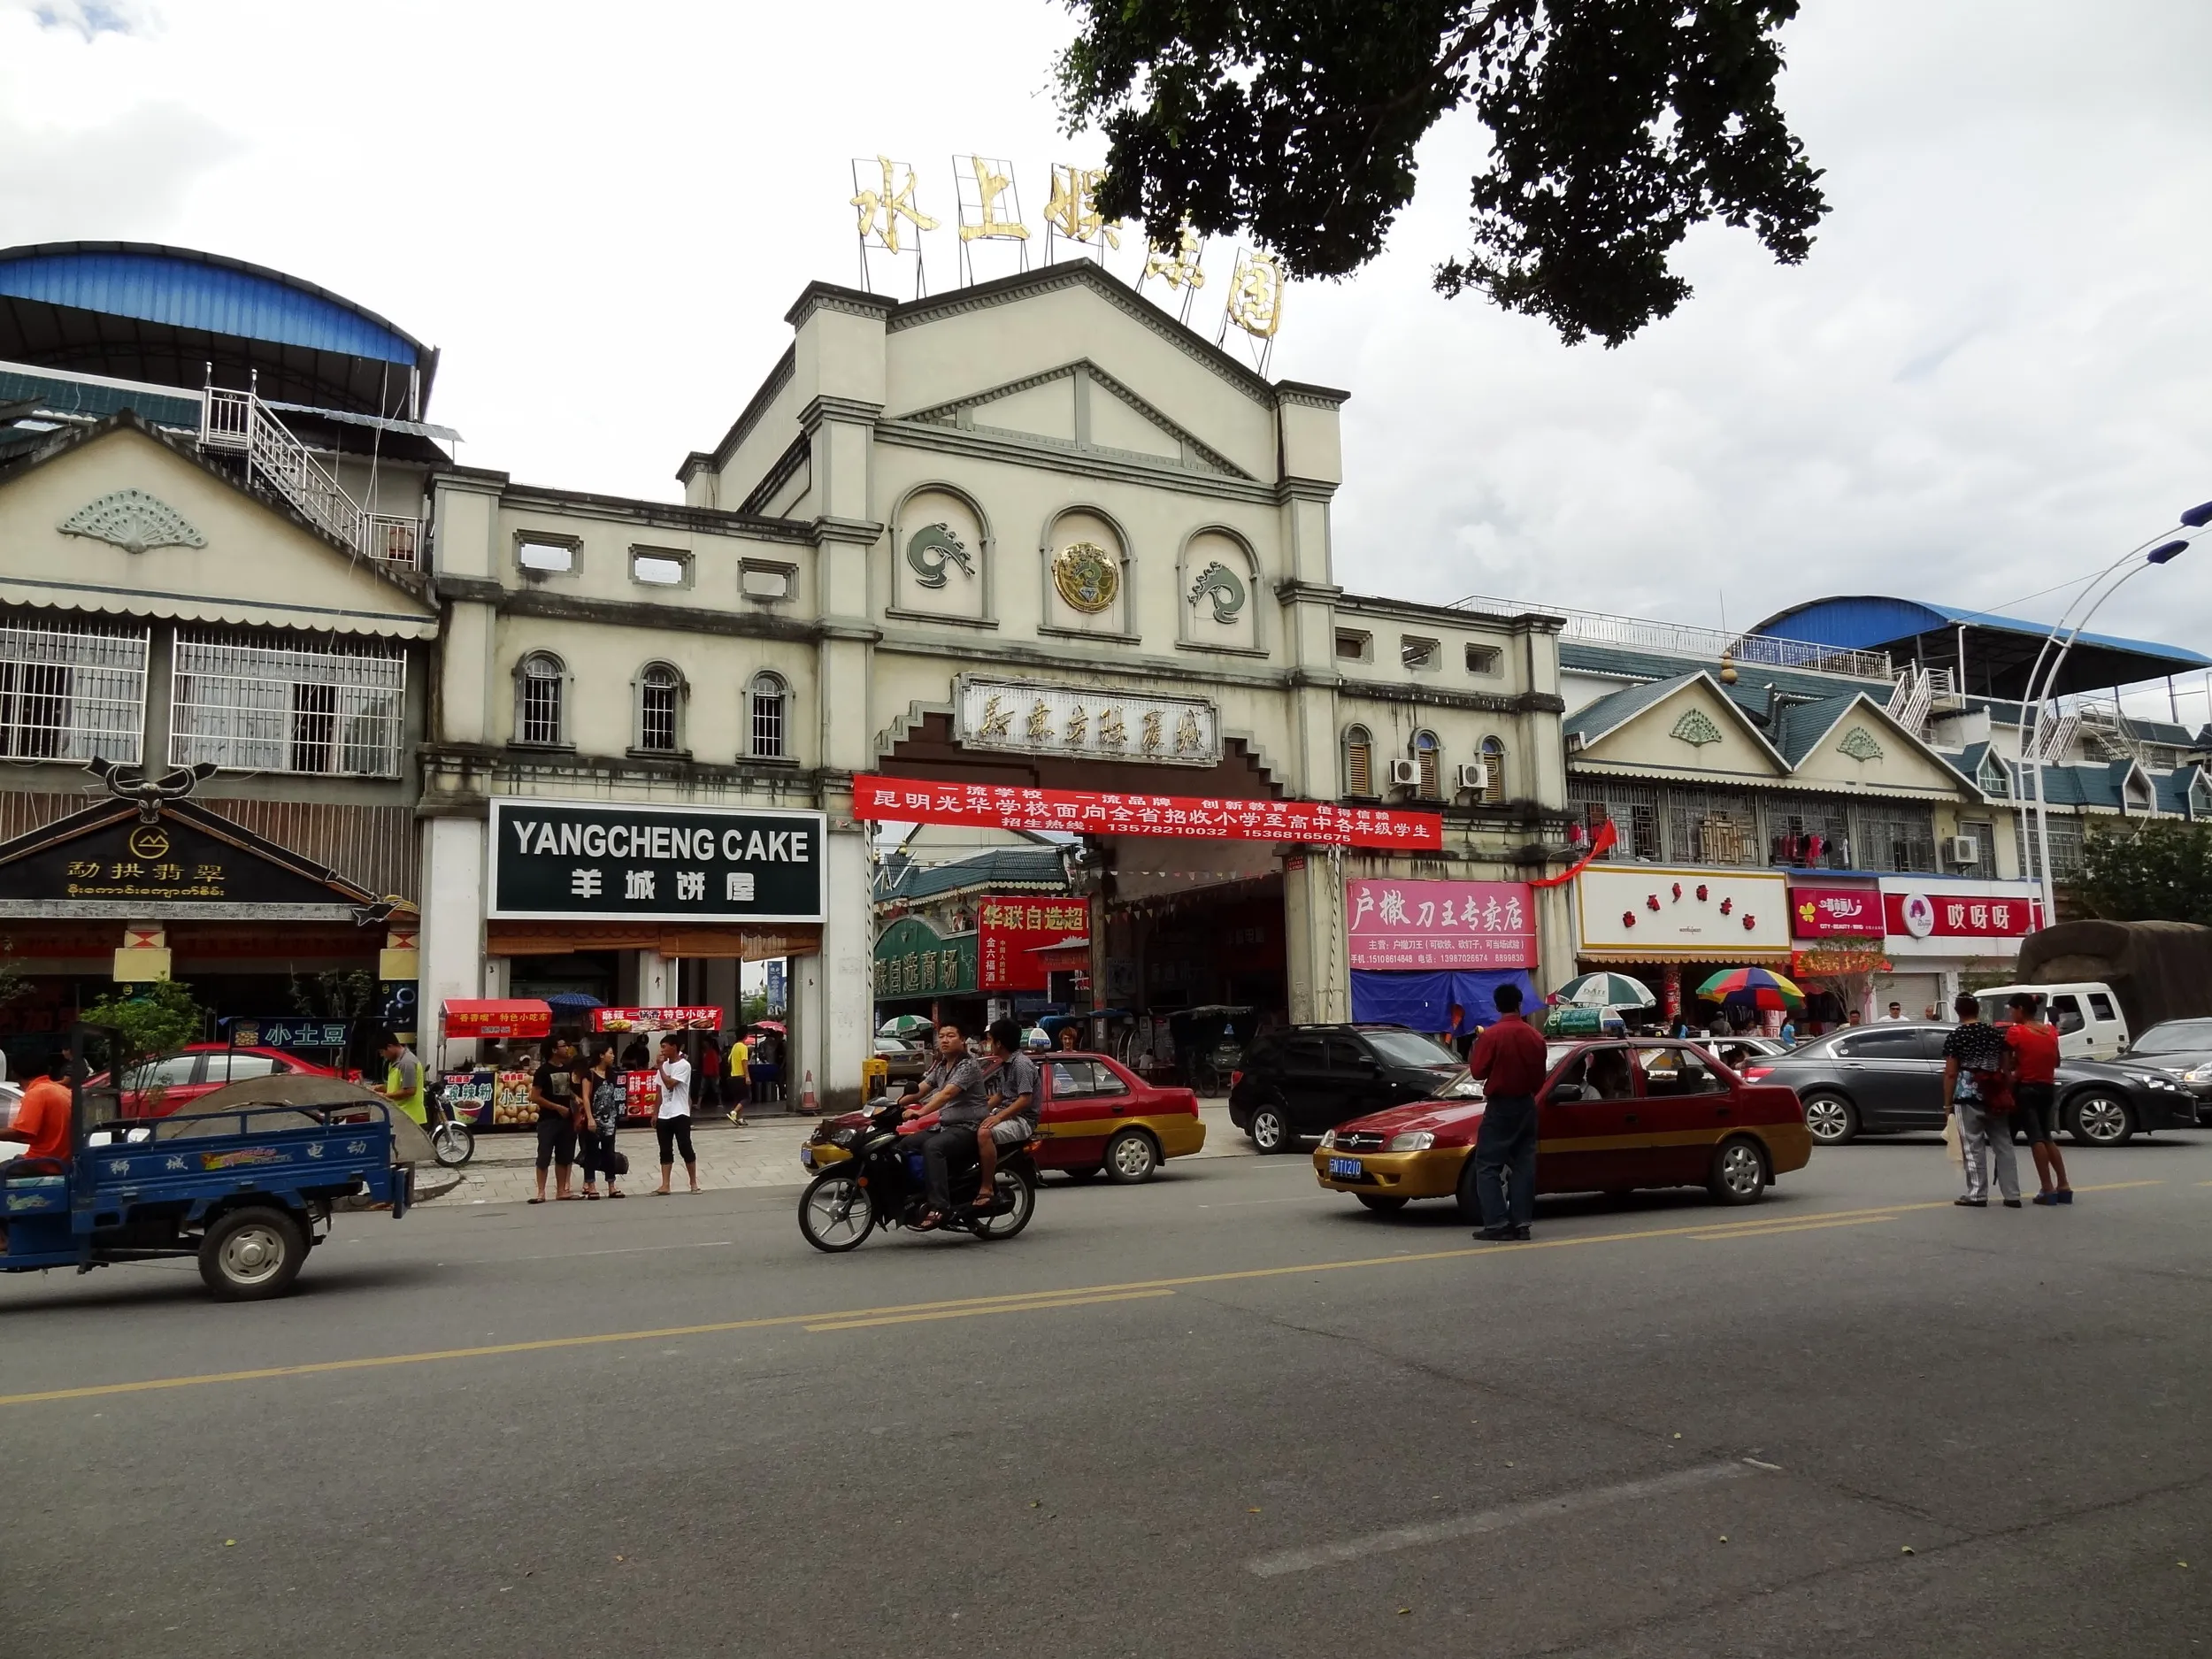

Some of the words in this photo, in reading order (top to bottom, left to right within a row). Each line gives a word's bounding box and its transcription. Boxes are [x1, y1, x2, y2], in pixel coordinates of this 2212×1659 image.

[873, 789, 1431, 838] 昆明光华学校面向全省招收小学至高中各年级学生
[938, 785, 1043, 800] 一流学校
[1075, 795, 1171, 807] 一流品牌
[1202, 800, 1288, 812] 创新教育
[1316, 805, 1390, 821] 值得信赖
[512, 820, 715, 861] YANGCHENG
[722, 829, 809, 863] CAKE
[1107, 823, 1227, 836] 13578210032
[1242, 829, 1351, 841] 15368165675
[67, 861, 226, 882] 勐拱翡翠
[571, 868, 755, 902] 羊城饼屋
[983, 904, 1089, 931] 华联自选超
[986, 937, 996, 982] 金六福酒
[499, 1012, 549, 1023] 特色小吃车
[663, 1010, 718, 1019] 特色小吃车
[265, 1023, 347, 1047] 小土豆
[307, 1141, 367, 1159] 电动
